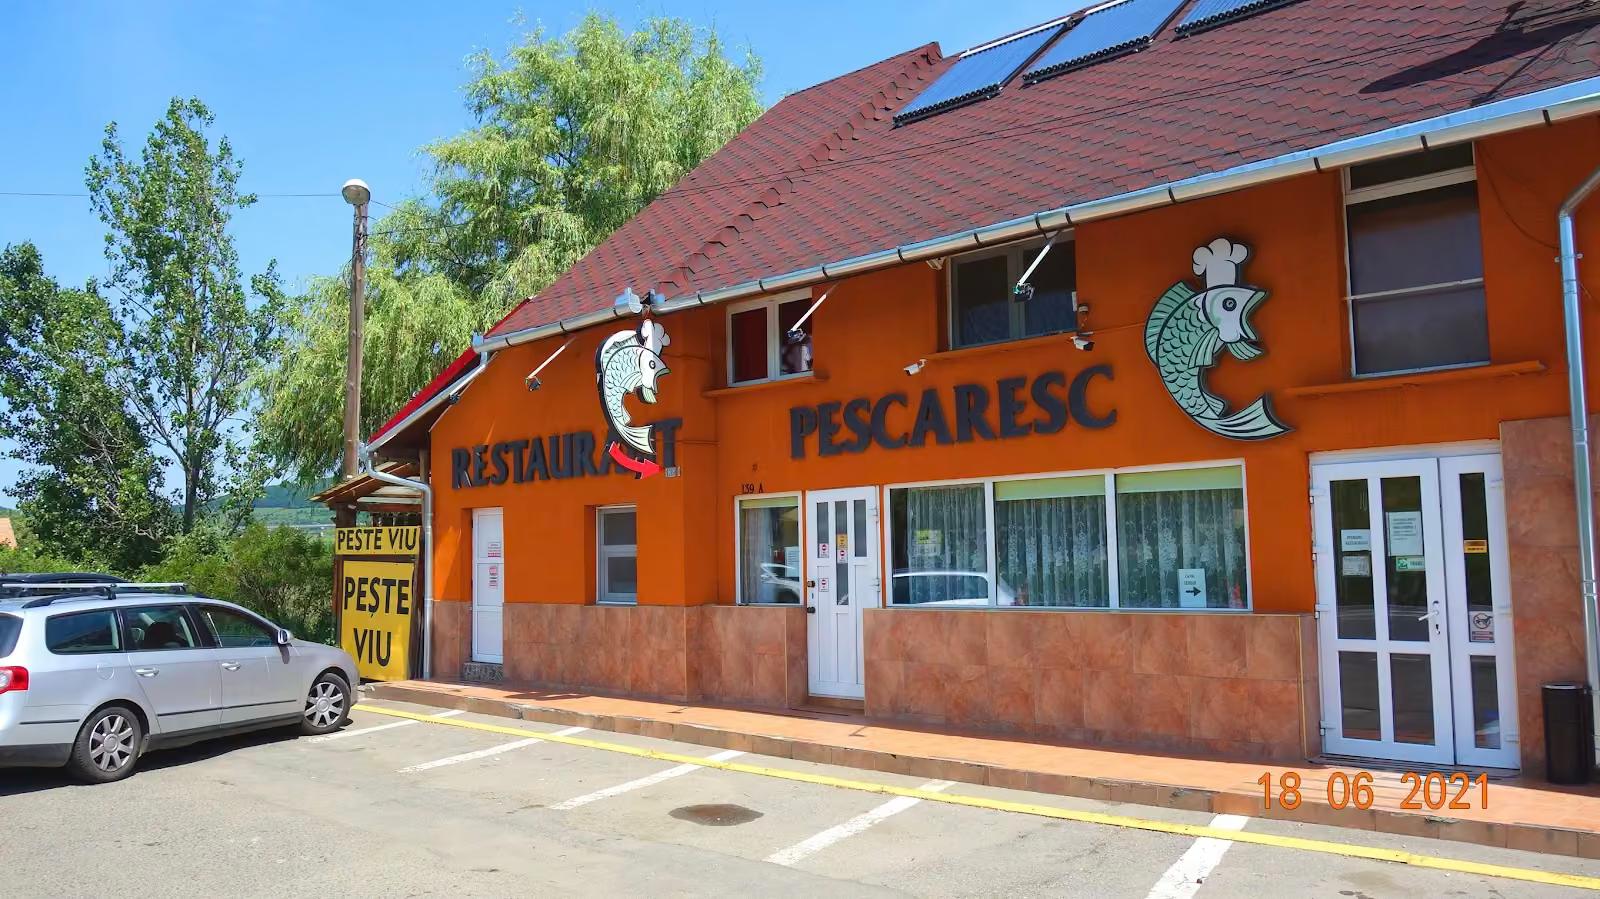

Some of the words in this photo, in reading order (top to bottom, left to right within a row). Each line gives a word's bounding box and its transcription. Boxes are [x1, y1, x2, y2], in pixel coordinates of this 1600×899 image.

[790, 364, 1117, 460] PESCARESC
[452, 418, 683, 489] RESTAURAT
[337, 528, 383, 551] PESTE
[388, 528, 417, 551] VIU
[344, 577, 410, 618] PEȘTE
[353, 628, 392, 667] VIU
